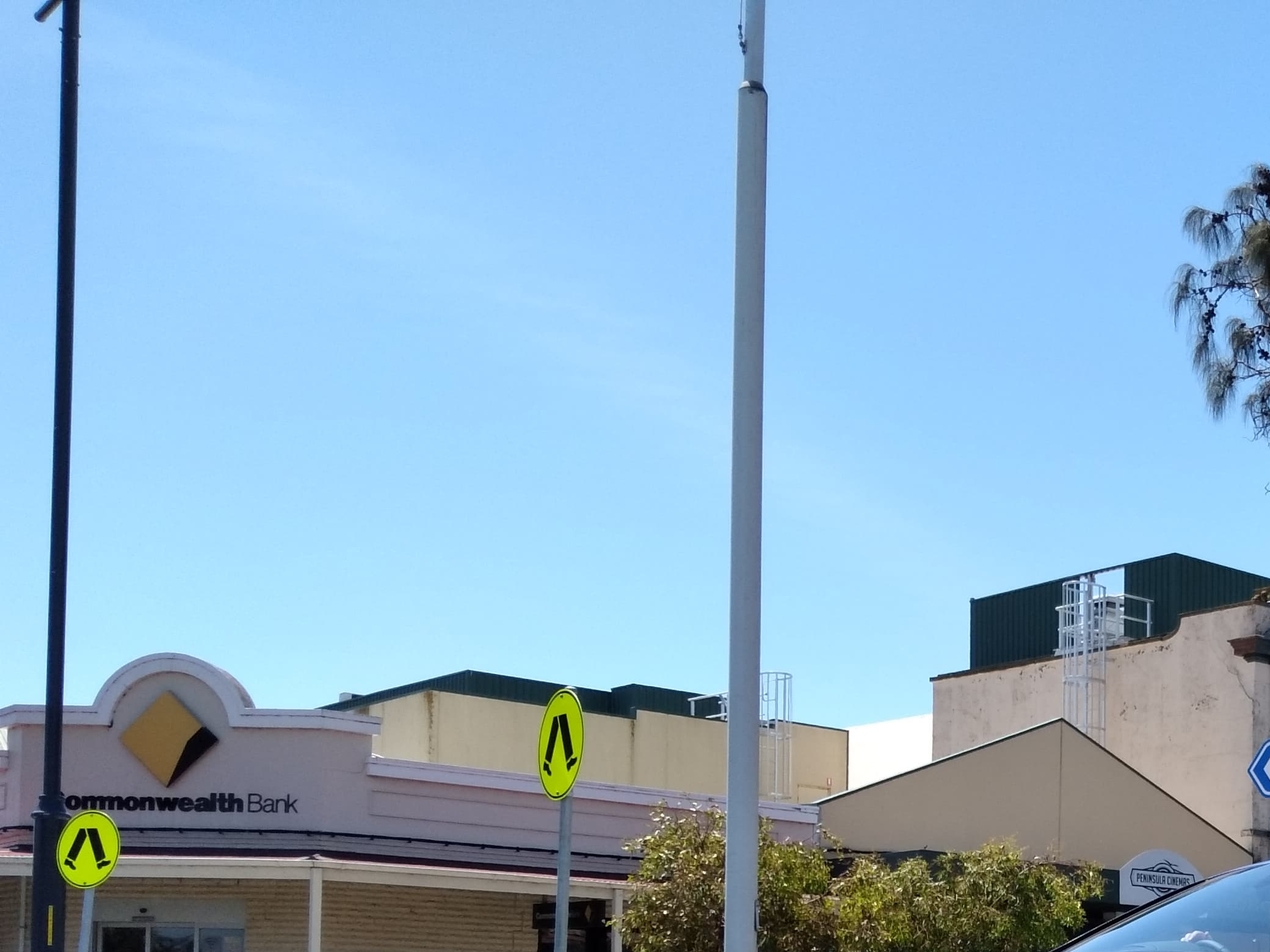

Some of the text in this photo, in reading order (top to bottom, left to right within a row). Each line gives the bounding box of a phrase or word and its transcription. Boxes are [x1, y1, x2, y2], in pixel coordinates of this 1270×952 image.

[63, 793, 298, 813] ommonwealth Bank
[1136, 873, 1190, 887] PENINSULA CINEMAS
